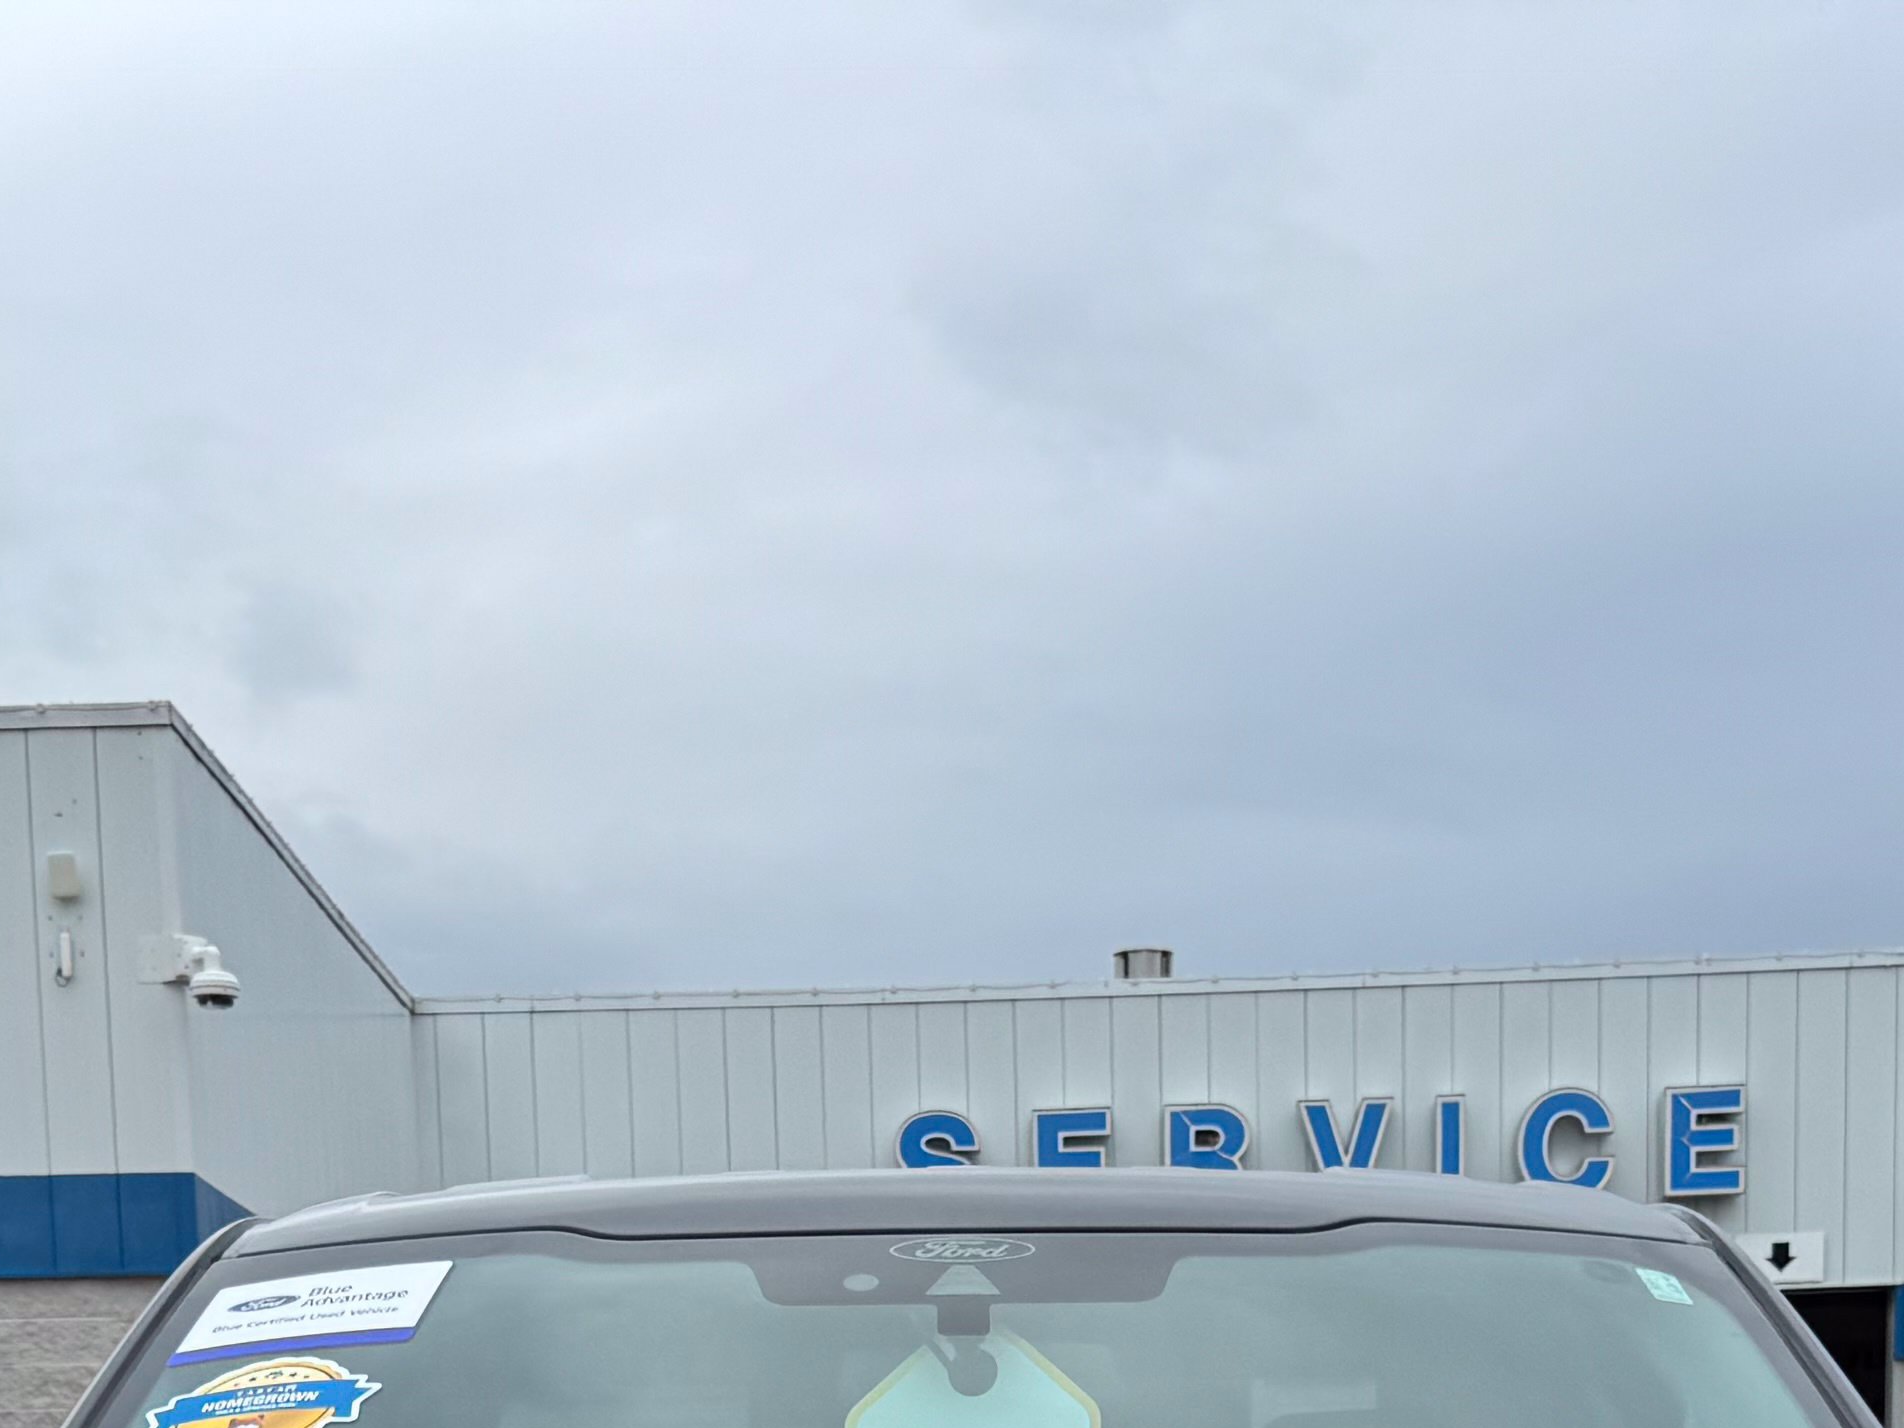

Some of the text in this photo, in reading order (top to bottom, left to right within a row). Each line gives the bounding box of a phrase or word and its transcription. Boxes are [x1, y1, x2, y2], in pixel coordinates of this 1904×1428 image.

[898, 1085, 1746, 1196] SERVICE
[915, 1241, 1010, 1258] Ford
[300, 1290, 408, 1307] Advantage
[309, 1285, 352, 1297] Blue
[201, 1391, 320, 1413] HOMEGROWN
